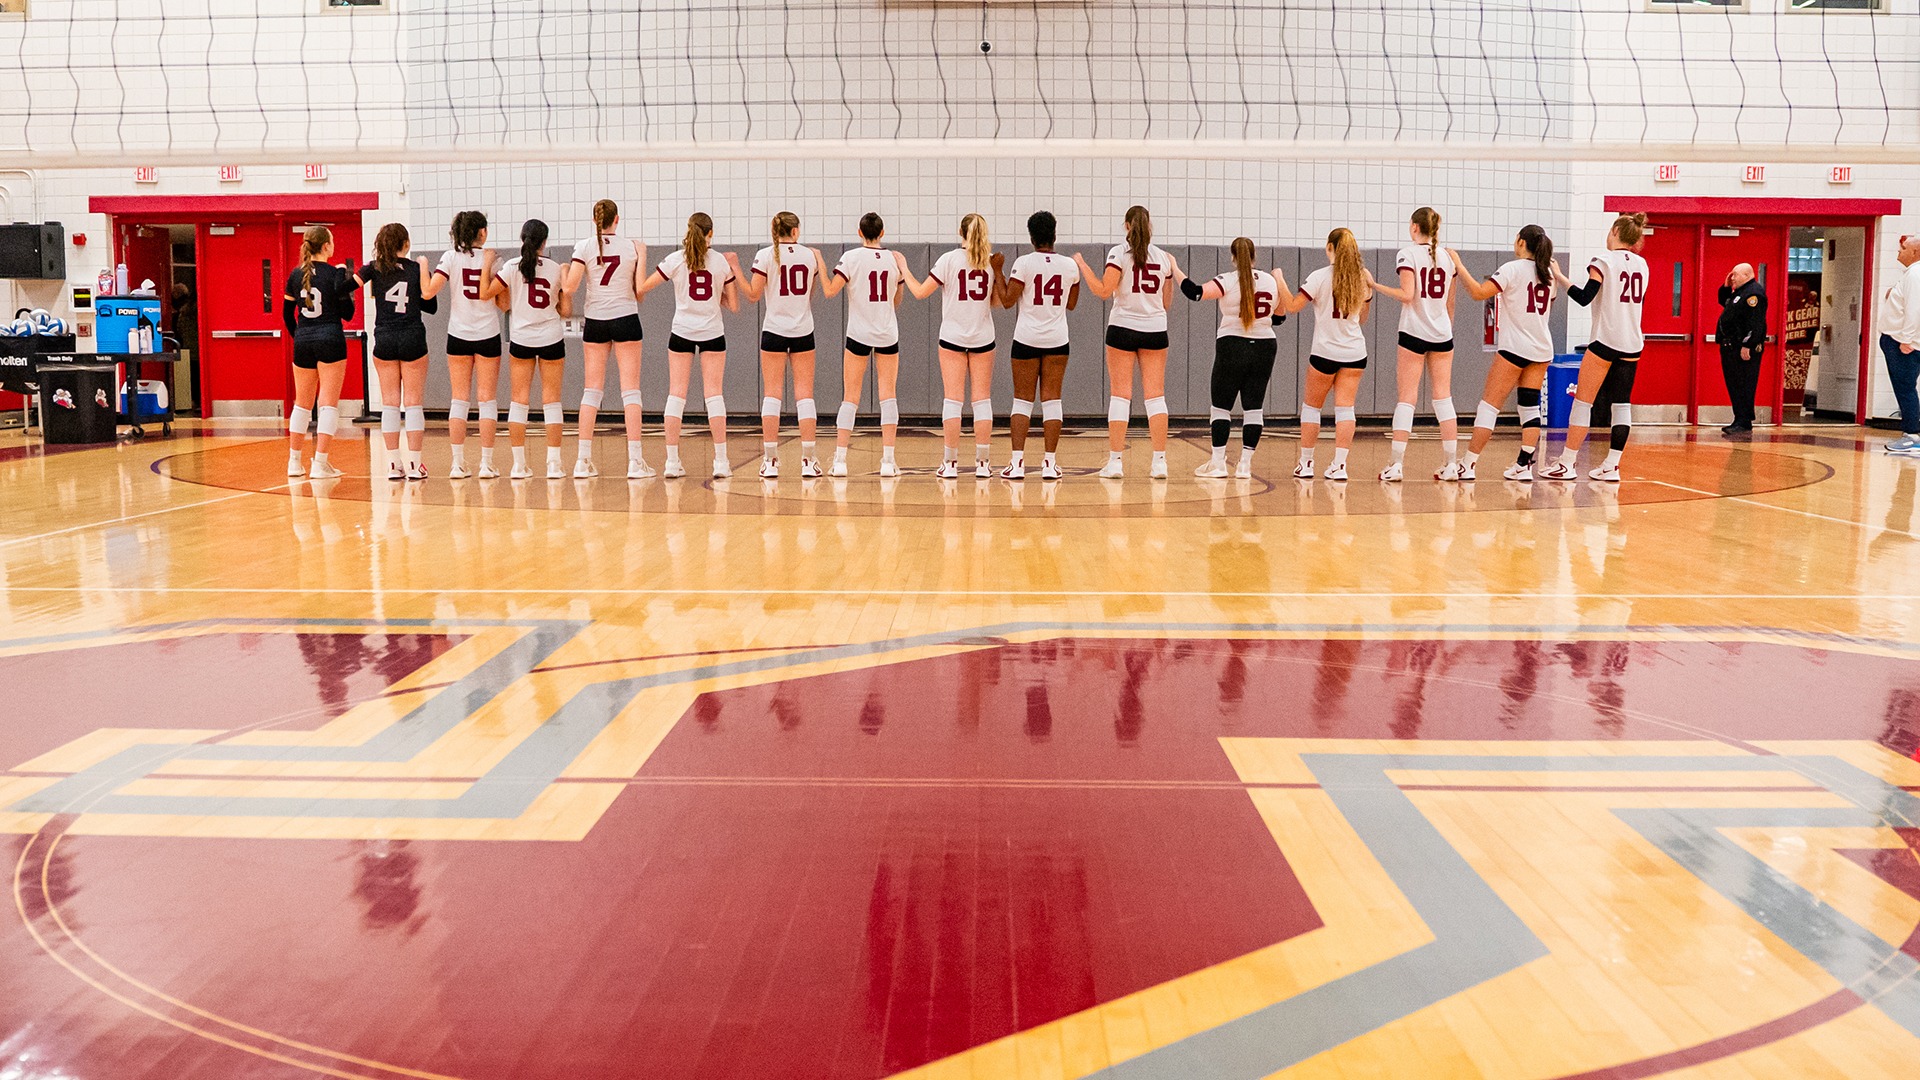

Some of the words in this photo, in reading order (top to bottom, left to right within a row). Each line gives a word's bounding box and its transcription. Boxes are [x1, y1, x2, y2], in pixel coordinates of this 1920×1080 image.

[137, 166, 154, 181] EXIT
[221, 165, 238, 180] EXIT
[306, 164, 322, 178] EXIT
[1660, 165, 1677, 180] EXIT
[1746, 166, 1764, 181] EXIT
[1833, 167, 1851, 182] EXIT
[596, 255, 621, 286] 7
[875, 252, 881, 260] S
[462, 268, 482, 301] 5
[527, 277, 551, 310] 6
[688, 270, 713, 302] 8
[779, 264, 809, 297] 10
[868, 270, 889, 302] 11
[957, 269, 989, 301] 13
[1033, 273, 1064, 306] 14
[1131, 263, 1161, 295] 15
[1419, 266, 1446, 299] 18
[1619, 271, 1644, 304] 20
[300, 287, 323, 319] 3
[385, 281, 410, 314] 4
[1526, 281, 1551, 316] 19
[1795, 307, 1820, 321] GEAR
